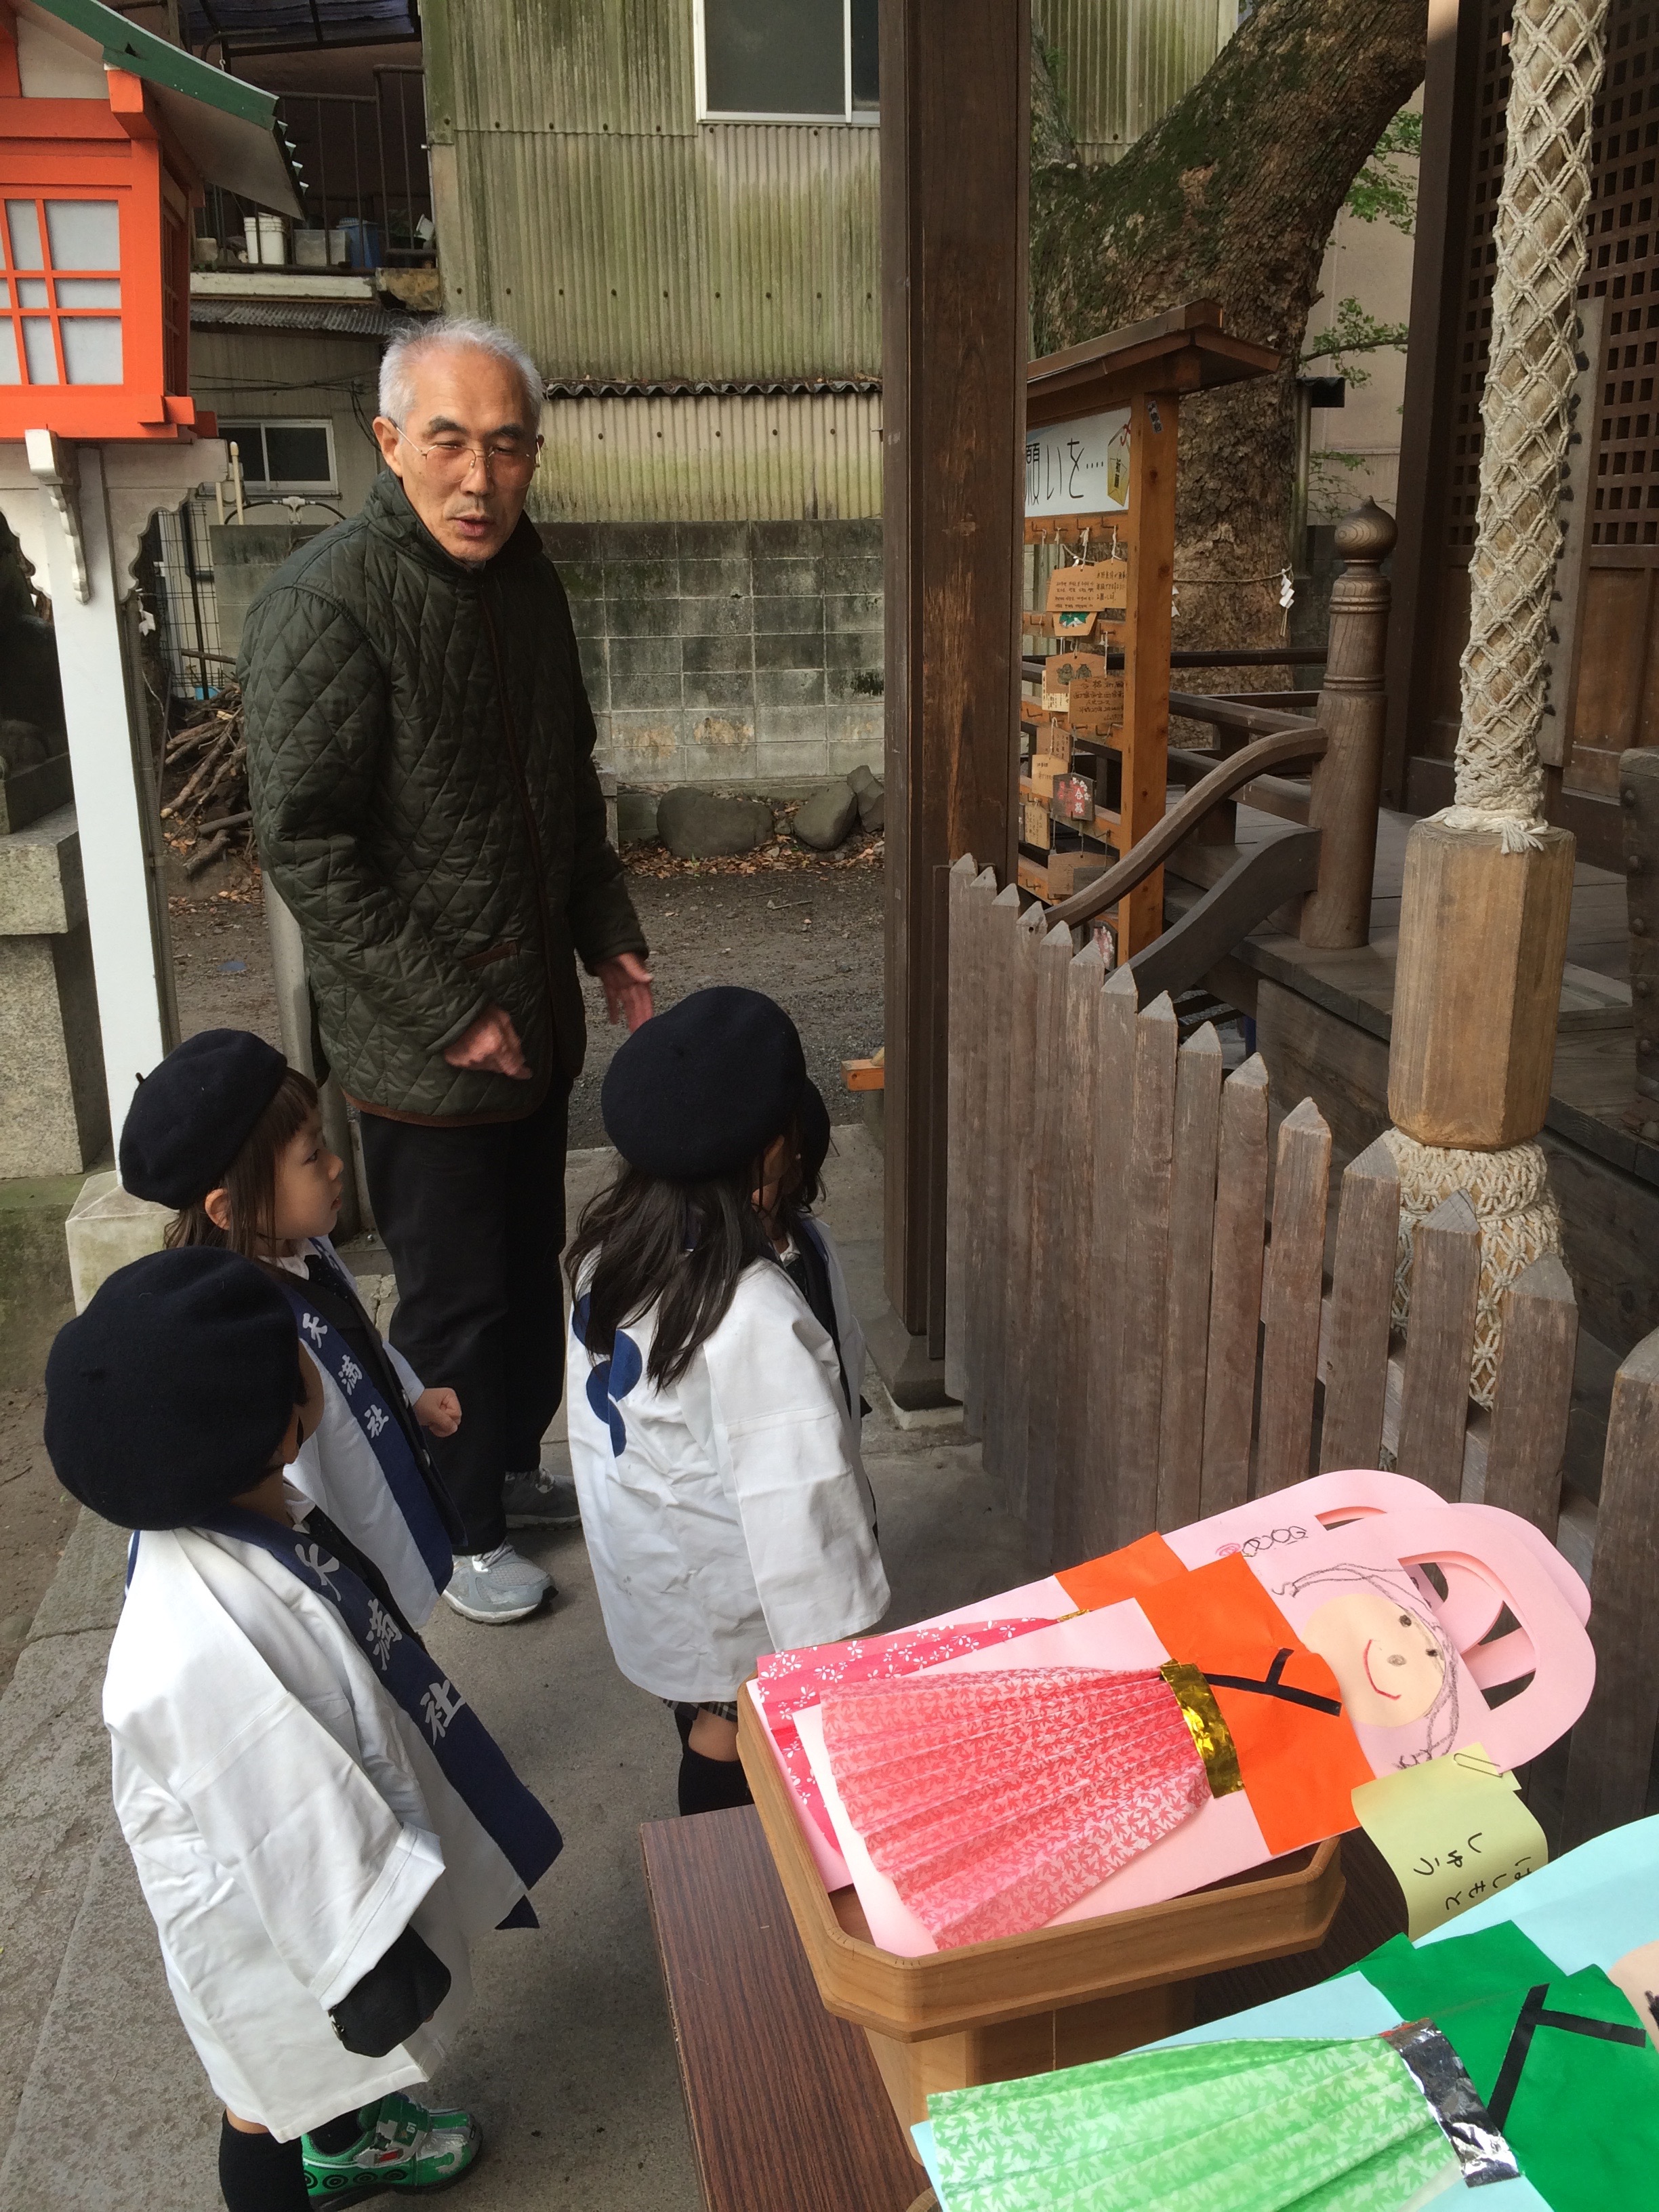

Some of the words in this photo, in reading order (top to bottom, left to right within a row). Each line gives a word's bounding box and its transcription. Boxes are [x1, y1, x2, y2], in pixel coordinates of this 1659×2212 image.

[302, 1312, 389, 1439] 天満社
[295, 1542, 466, 1746] 天満社
